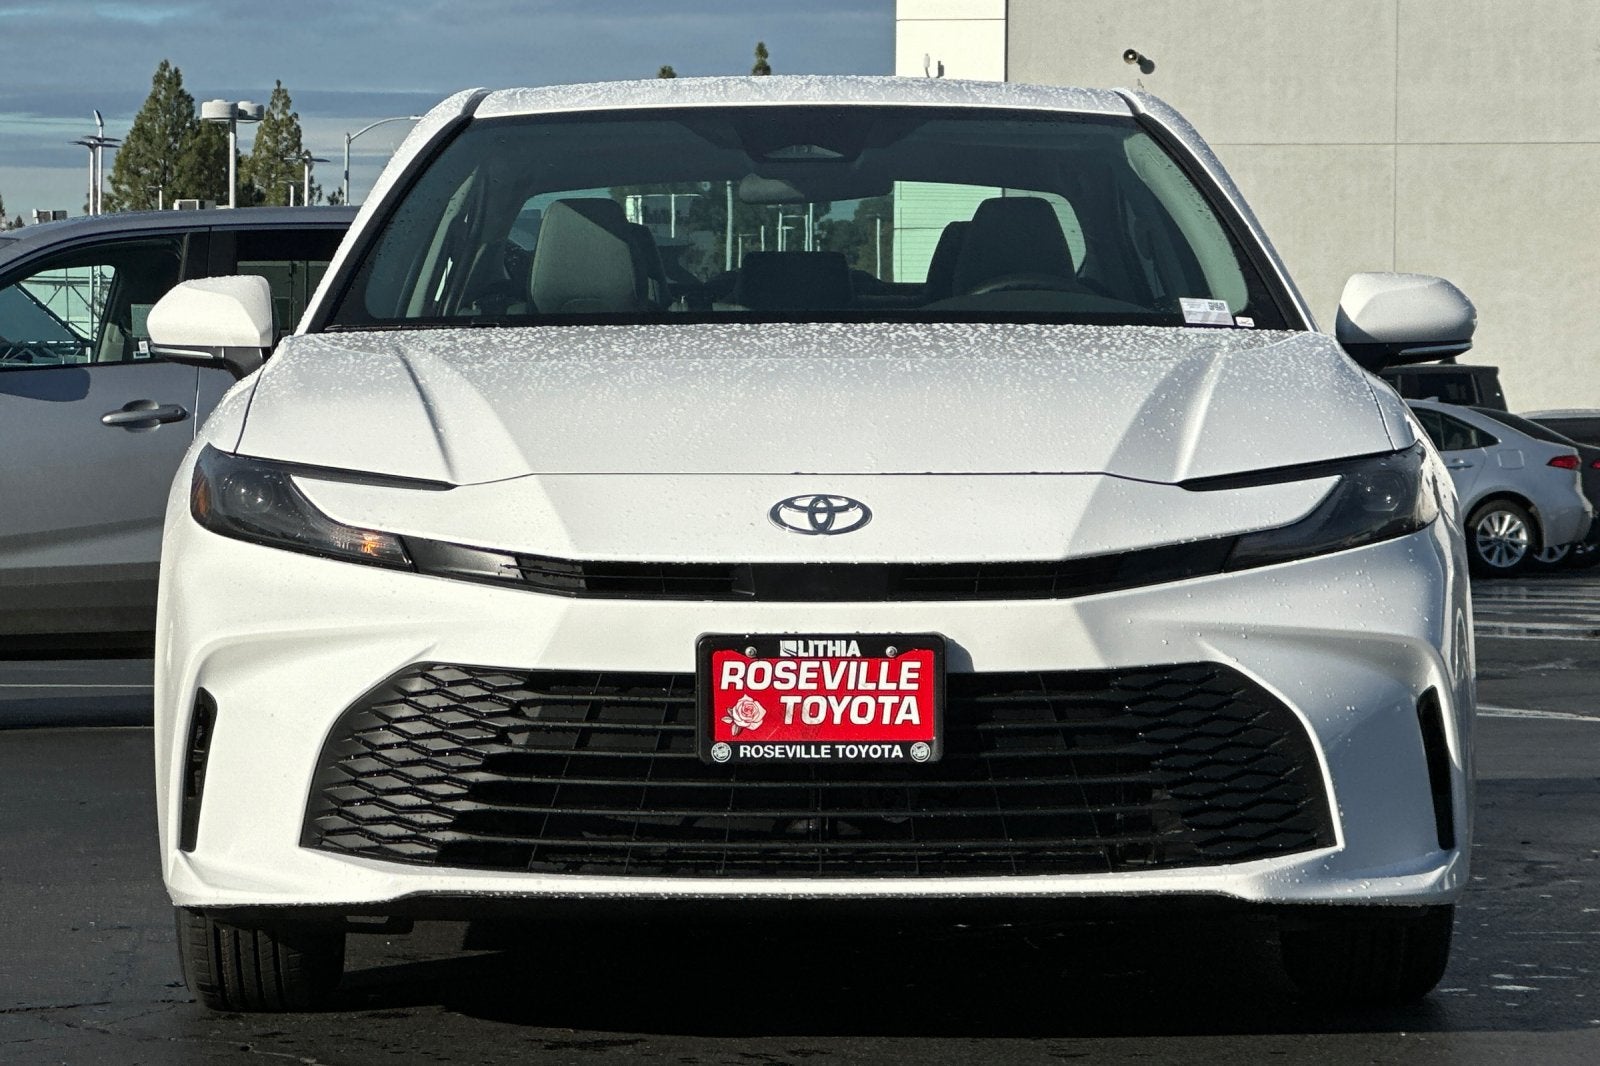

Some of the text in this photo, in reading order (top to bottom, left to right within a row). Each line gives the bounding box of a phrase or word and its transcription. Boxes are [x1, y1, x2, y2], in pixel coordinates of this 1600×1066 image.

[798, 640, 861, 657] LITHIA
[720, 660, 922, 691] ROSEVILLE
[779, 695, 921, 725] TOYOTA
[739, 744, 831, 758] ROSEVILLE
[835, 744, 903, 758] TOYOTA
